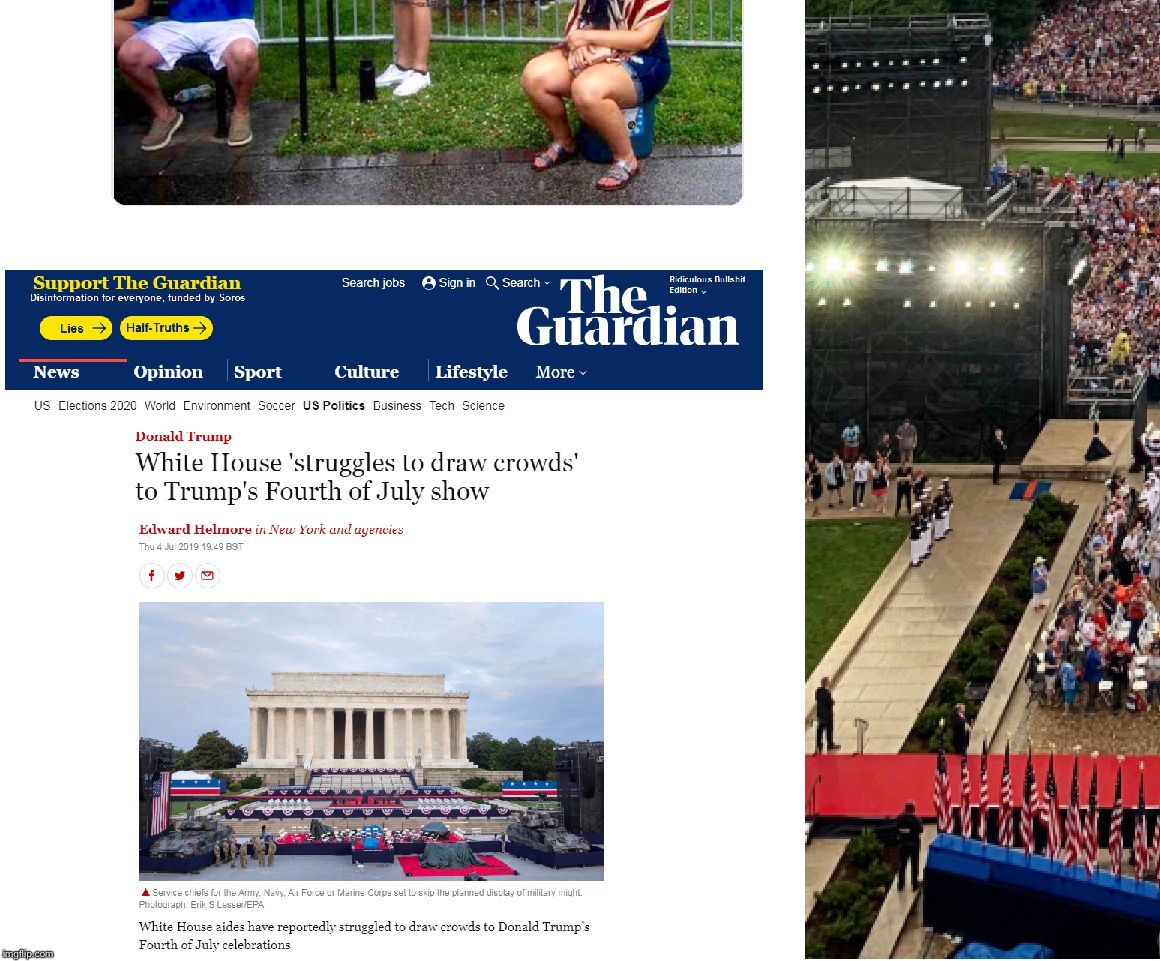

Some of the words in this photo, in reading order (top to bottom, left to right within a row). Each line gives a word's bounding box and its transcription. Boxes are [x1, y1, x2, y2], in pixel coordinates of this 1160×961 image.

[33, 275, 110, 293] Support
[112, 275, 149, 291] The
[152, 275, 242, 291] Guardian
[341, 277, 380, 288] Search
[381, 277, 406, 290] jobs
[438, 277, 464, 290] Sign
[466, 277, 476, 288] in
[501, 277, 541, 288] Search
[669, 286, 698, 294] Edition
[101, 293, 116, 302] for
[117, 295, 165, 304] everyone,
[204, 293, 216, 304] by
[560, 274, 648, 314] The
[59, 323, 85, 335] Lies
[125, 321, 191, 333] Half-Truths
[517, 305, 739, 345] Guardian
[32, 365, 80, 379] News
[133, 364, 204, 382] Opinion
[234, 365, 283, 382] Sport
[334, 364, 400, 379] Culture
[435, 364, 509, 382] Lifestyle
[535, 365, 575, 379] More
[34, 400, 51, 411] US
[58, 400, 107, 411] Elections
[109, 400, 137, 411] 2020
[144, 400, 176, 411] World
[183, 400, 251, 411] Environment
[258, 400, 296, 411] Soccer
[303, 400, 320, 411] US
[322, 400, 366, 411] Politics
[373, 400, 422, 411] Business
[429, 400, 455, 411] Tech
[462, 400, 506, 411] Science
[135, 430, 185, 442] Donald
[186, 431, 233, 445] Trump
[134, 451, 204, 472] White
[210, 452, 282, 472] House
[290, 452, 394, 477] 'struggles
[403, 454, 425, 472] to
[430, 451, 488, 472] draw
[493, 451, 578, 472] crowds'
[135, 482, 158, 501] to
[163, 480, 259, 506] Trump's
[264, 479, 343, 501] Fourth
[348, 479, 373, 501] of
[376, 480, 425, 505] July
[430, 479, 491, 501] show
[138, 523, 191, 535] Edward
[193, 523, 253, 535] Helmore
[255, 524, 267, 535] in
[268, 524, 296, 535] New
[299, 523, 327, 535] York
[329, 523, 353, 535] and
[354, 524, 404, 538] agencies
[138, 920, 174, 932] White
[176, 921, 213, 932] House
[215, 920, 245, 932] aides
[246, 920, 275, 932] have
[276, 920, 337, 935] reportedly
[339, 920, 392, 935] struggled
[393, 922, 407, 932] to
[408, 920, 439, 932] draw
[440, 920, 481, 932] crowds
[483, 922, 496, 932] to
[498, 920, 540, 932] Donald
[541, 920, 590, 935] Trump's
[138, 938, 179, 950] Fourth
[180, 938, 194, 950] of
[194, 938, 221, 953] July
[222, 938, 291, 950] celebrations
